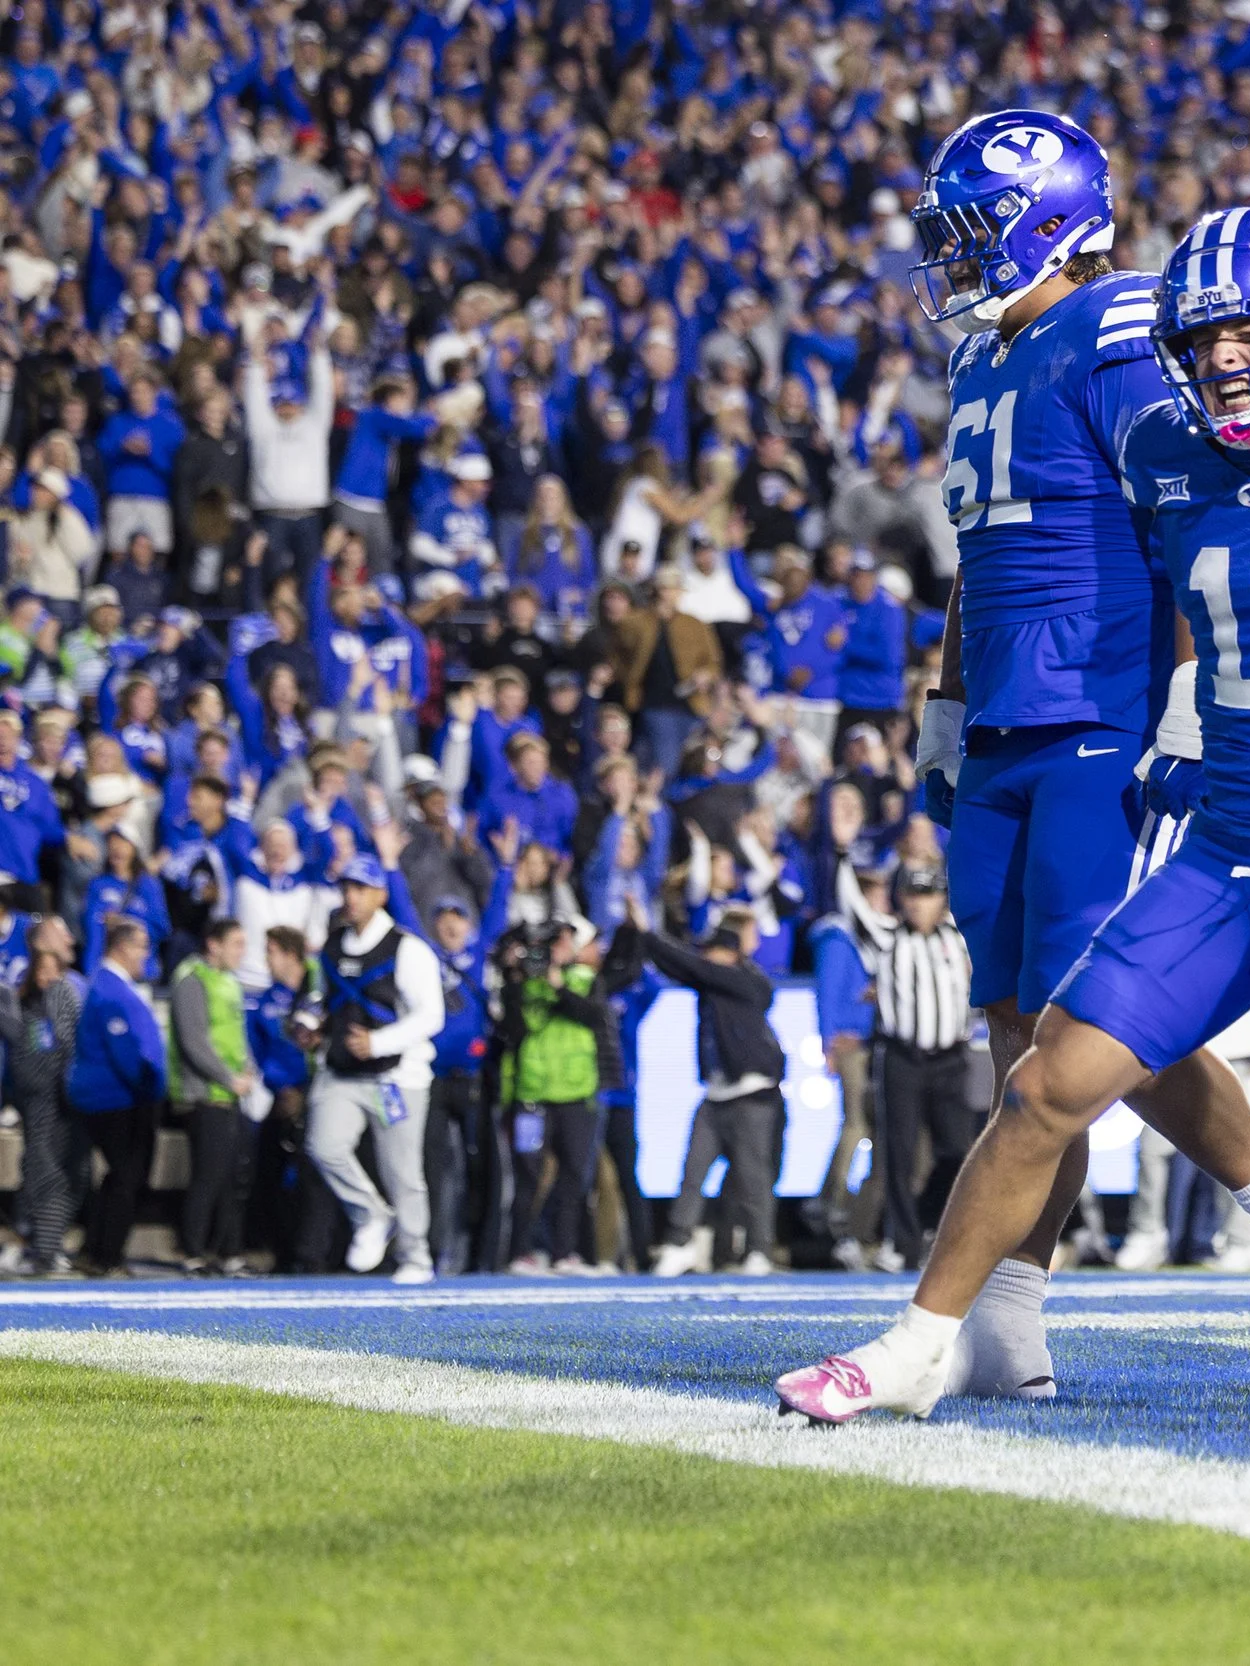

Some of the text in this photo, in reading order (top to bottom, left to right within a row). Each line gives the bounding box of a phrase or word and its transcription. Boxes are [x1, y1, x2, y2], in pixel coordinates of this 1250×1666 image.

[991, 131, 1045, 168] Y
[1197, 290, 1222, 305] BYU
[942, 389, 1033, 532] 61
